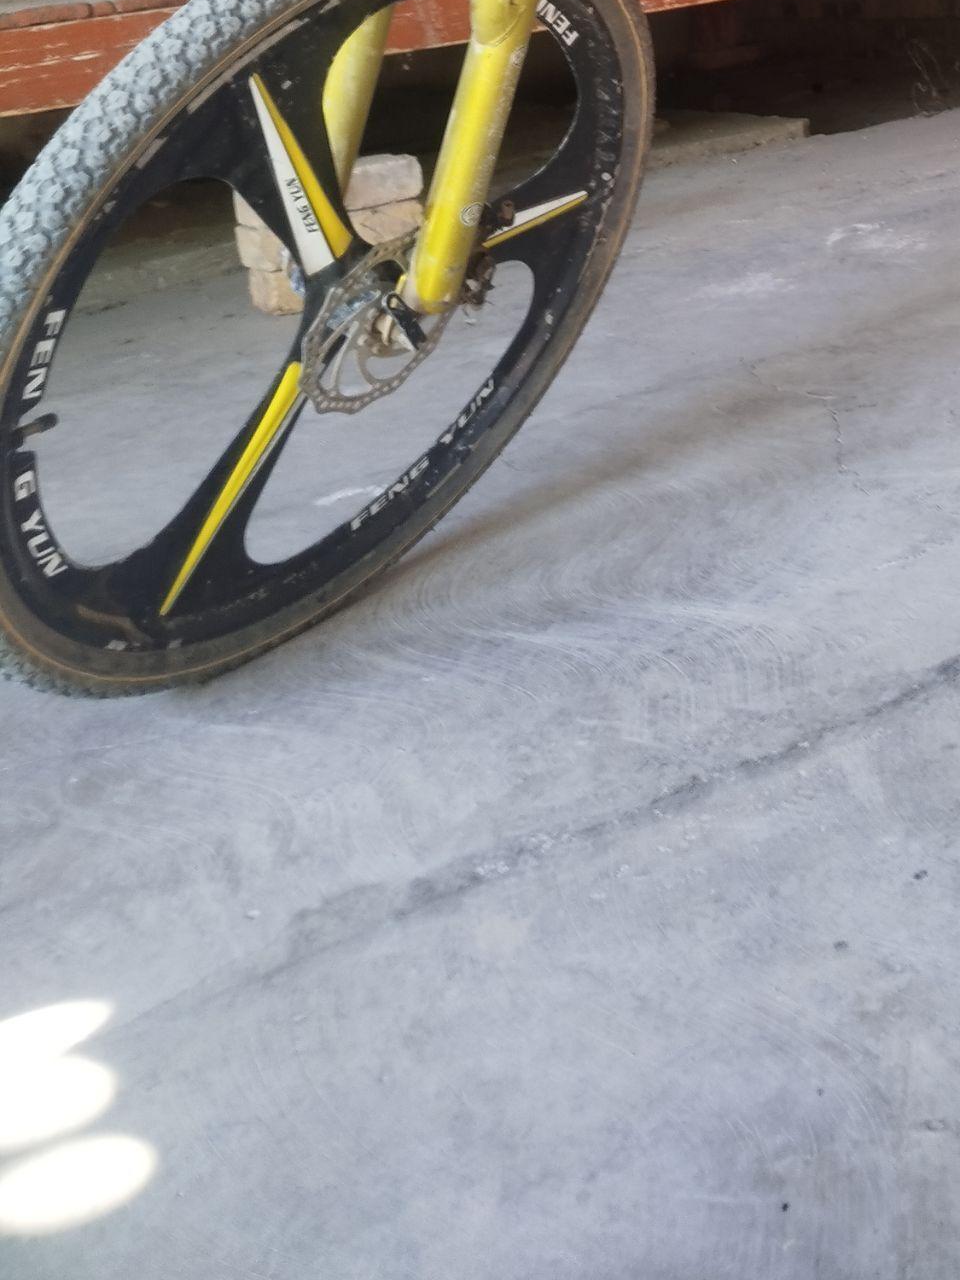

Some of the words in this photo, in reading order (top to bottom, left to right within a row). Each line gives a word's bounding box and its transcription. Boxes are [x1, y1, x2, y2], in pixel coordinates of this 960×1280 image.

[285, 177, 304, 202] YUN
[297, 205, 320, 233] FENG
[351, 455, 430, 531] FENG
[439, 378, 494, 444] YUN
[20, 508, 68, 578] YUN
